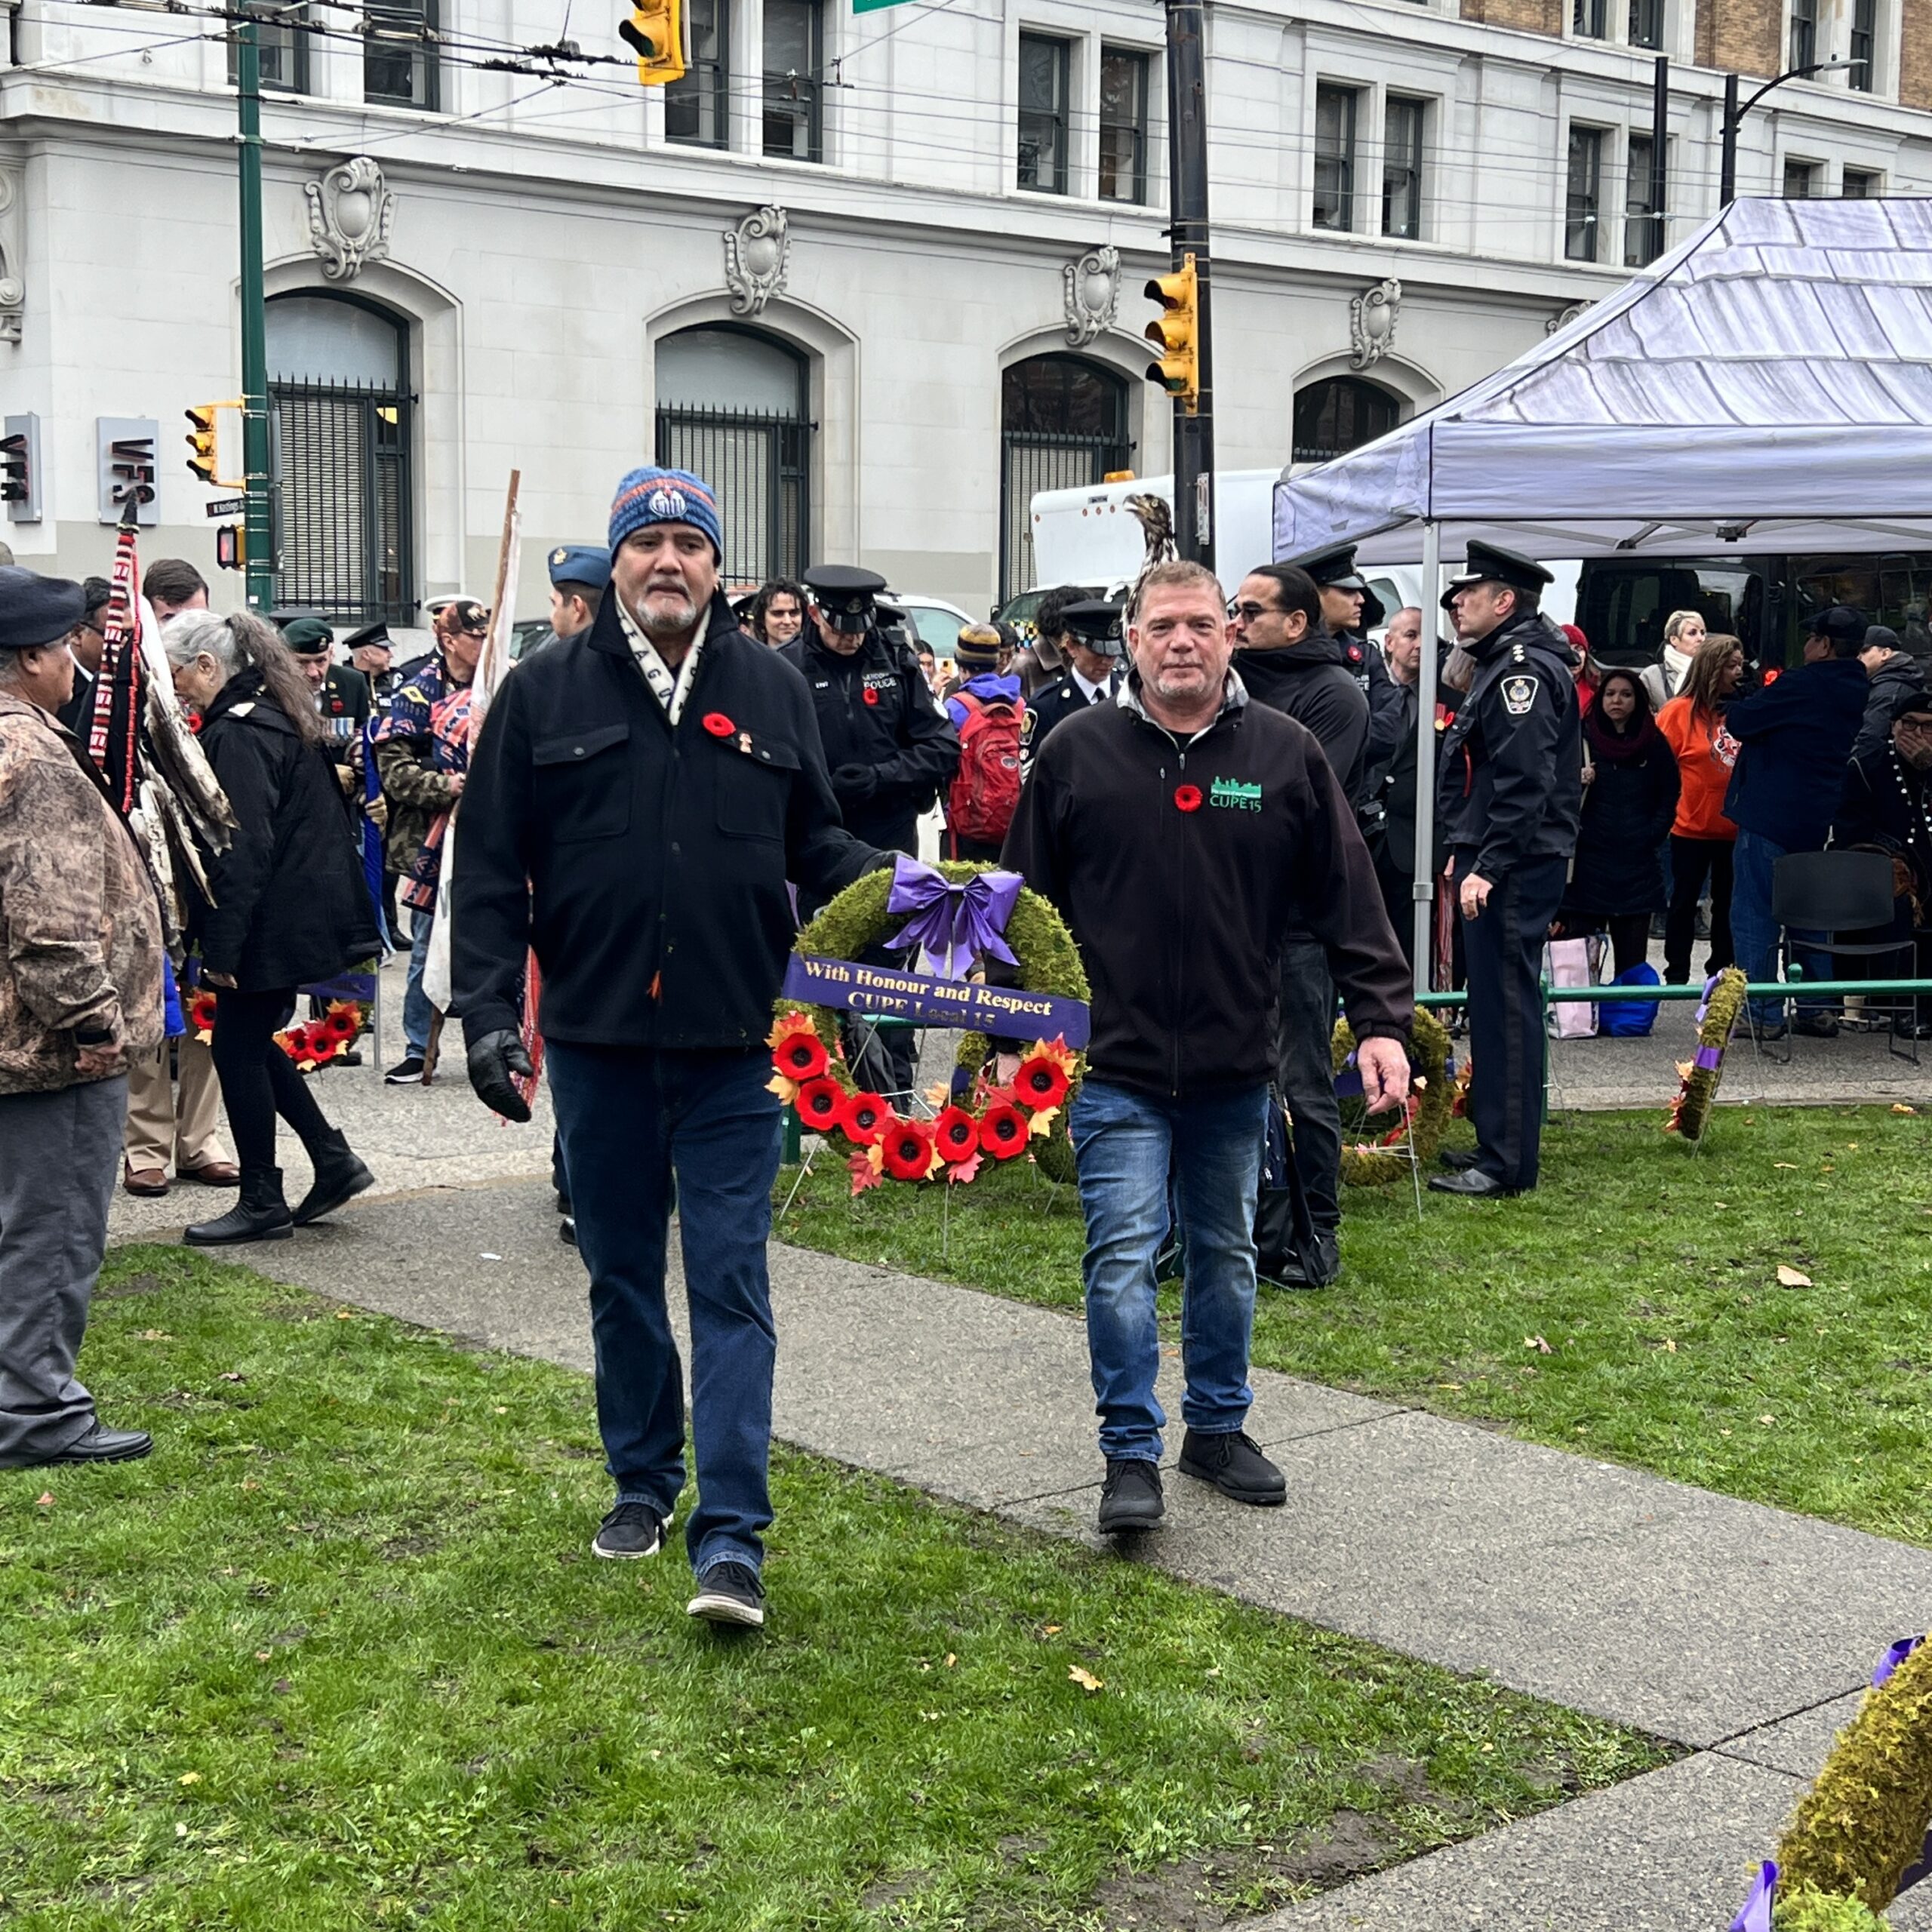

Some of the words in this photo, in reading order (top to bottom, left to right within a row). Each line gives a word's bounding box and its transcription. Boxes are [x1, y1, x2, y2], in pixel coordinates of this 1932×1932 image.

[112, 438, 155, 503] VFS
[804, 961, 850, 983] With
[856, 968, 931, 995] Honour
[934, 985, 971, 1002] and
[975, 989, 1053, 1016] Respect
[848, 991, 908, 1015] CUPE
[974, 1012, 995, 1029] 15
